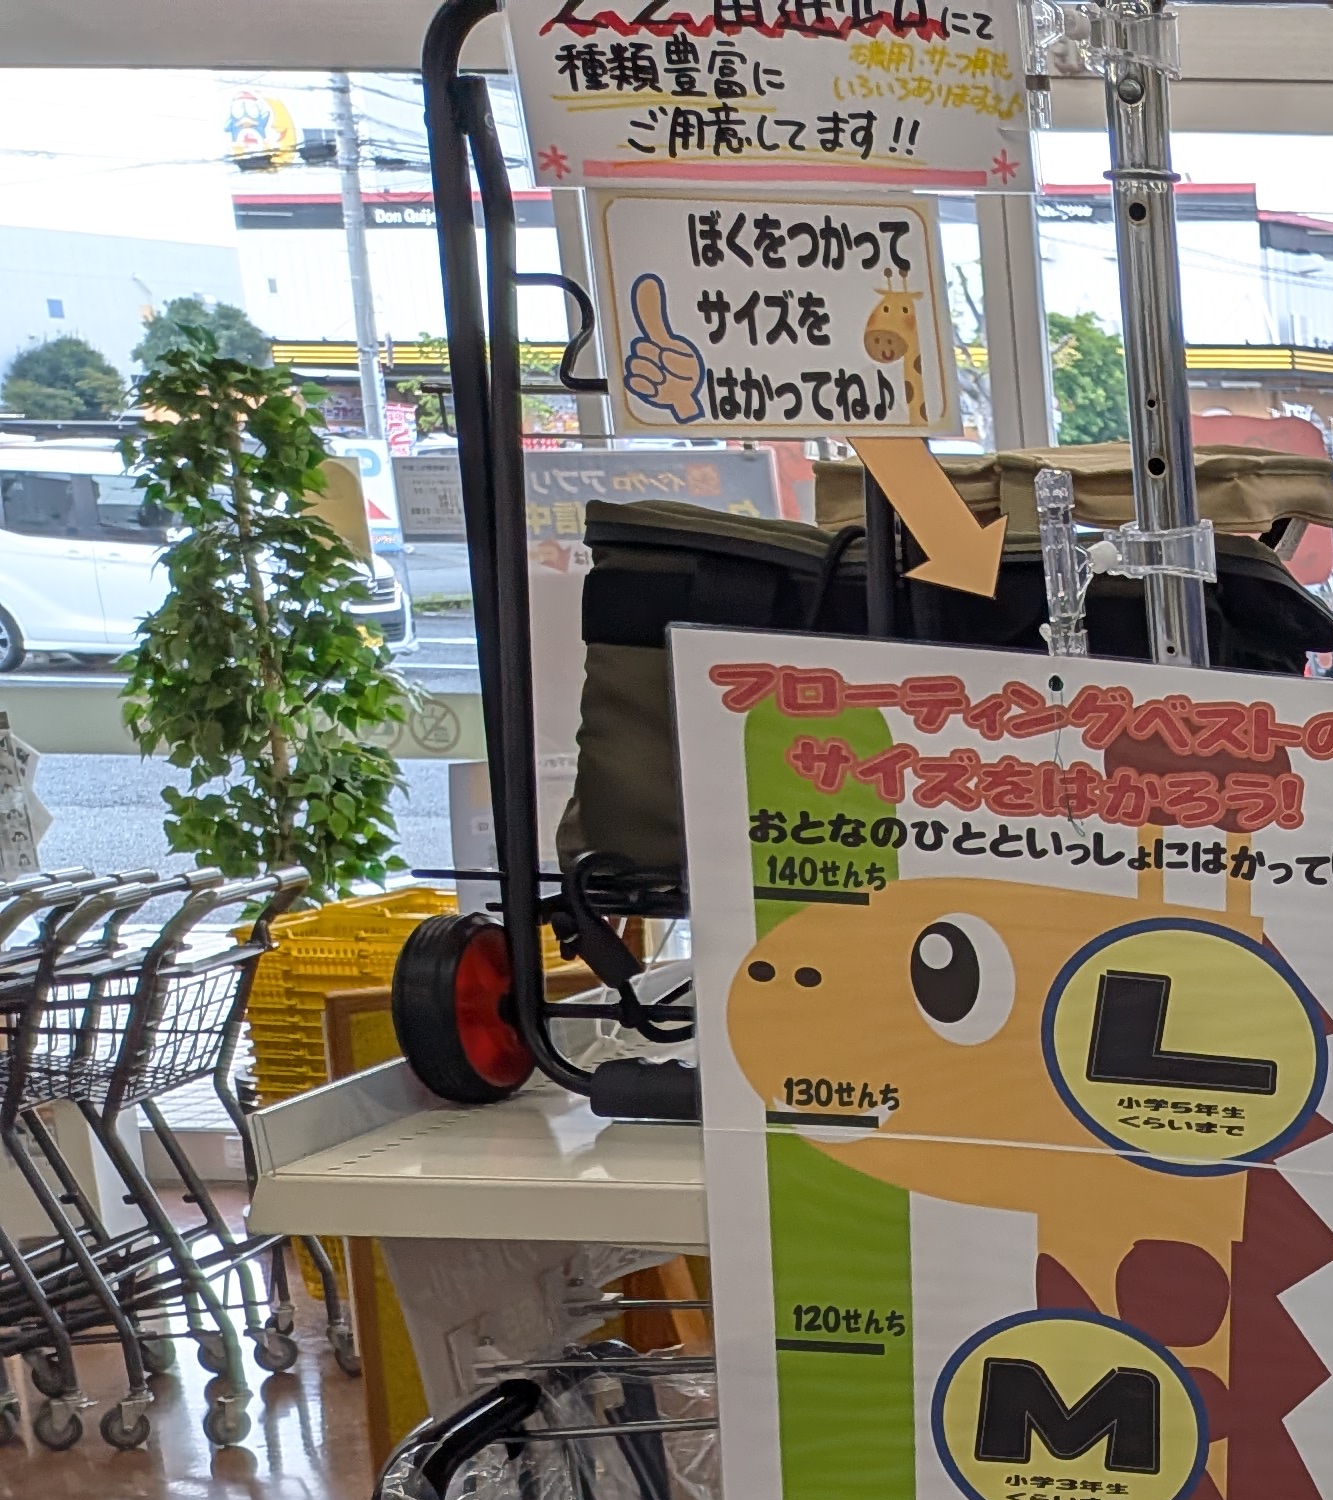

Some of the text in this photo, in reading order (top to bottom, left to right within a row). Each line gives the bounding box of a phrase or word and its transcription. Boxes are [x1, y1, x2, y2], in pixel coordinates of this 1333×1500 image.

[555, 32, 785, 99] 種類豊富に
[689, 213, 910, 271] ぼくをつかって
[698, 290, 831, 346] サイズを
[785, 735, 1305, 831] サイズをはかろう！
[767, 855, 887, 891] 140せんち
[1086, 969, 1277, 1096] L
[784, 1077, 901, 1111] 130せんち
[1117, 1096, 1246, 1121] 小学5年生
[1117, 1115, 1245, 1138] くらいまで
[793, 1305, 906, 1337] 120せんち
[974, 1357, 1160, 1475] M
[1004, 1473, 1129, 1496] 小学3年生
